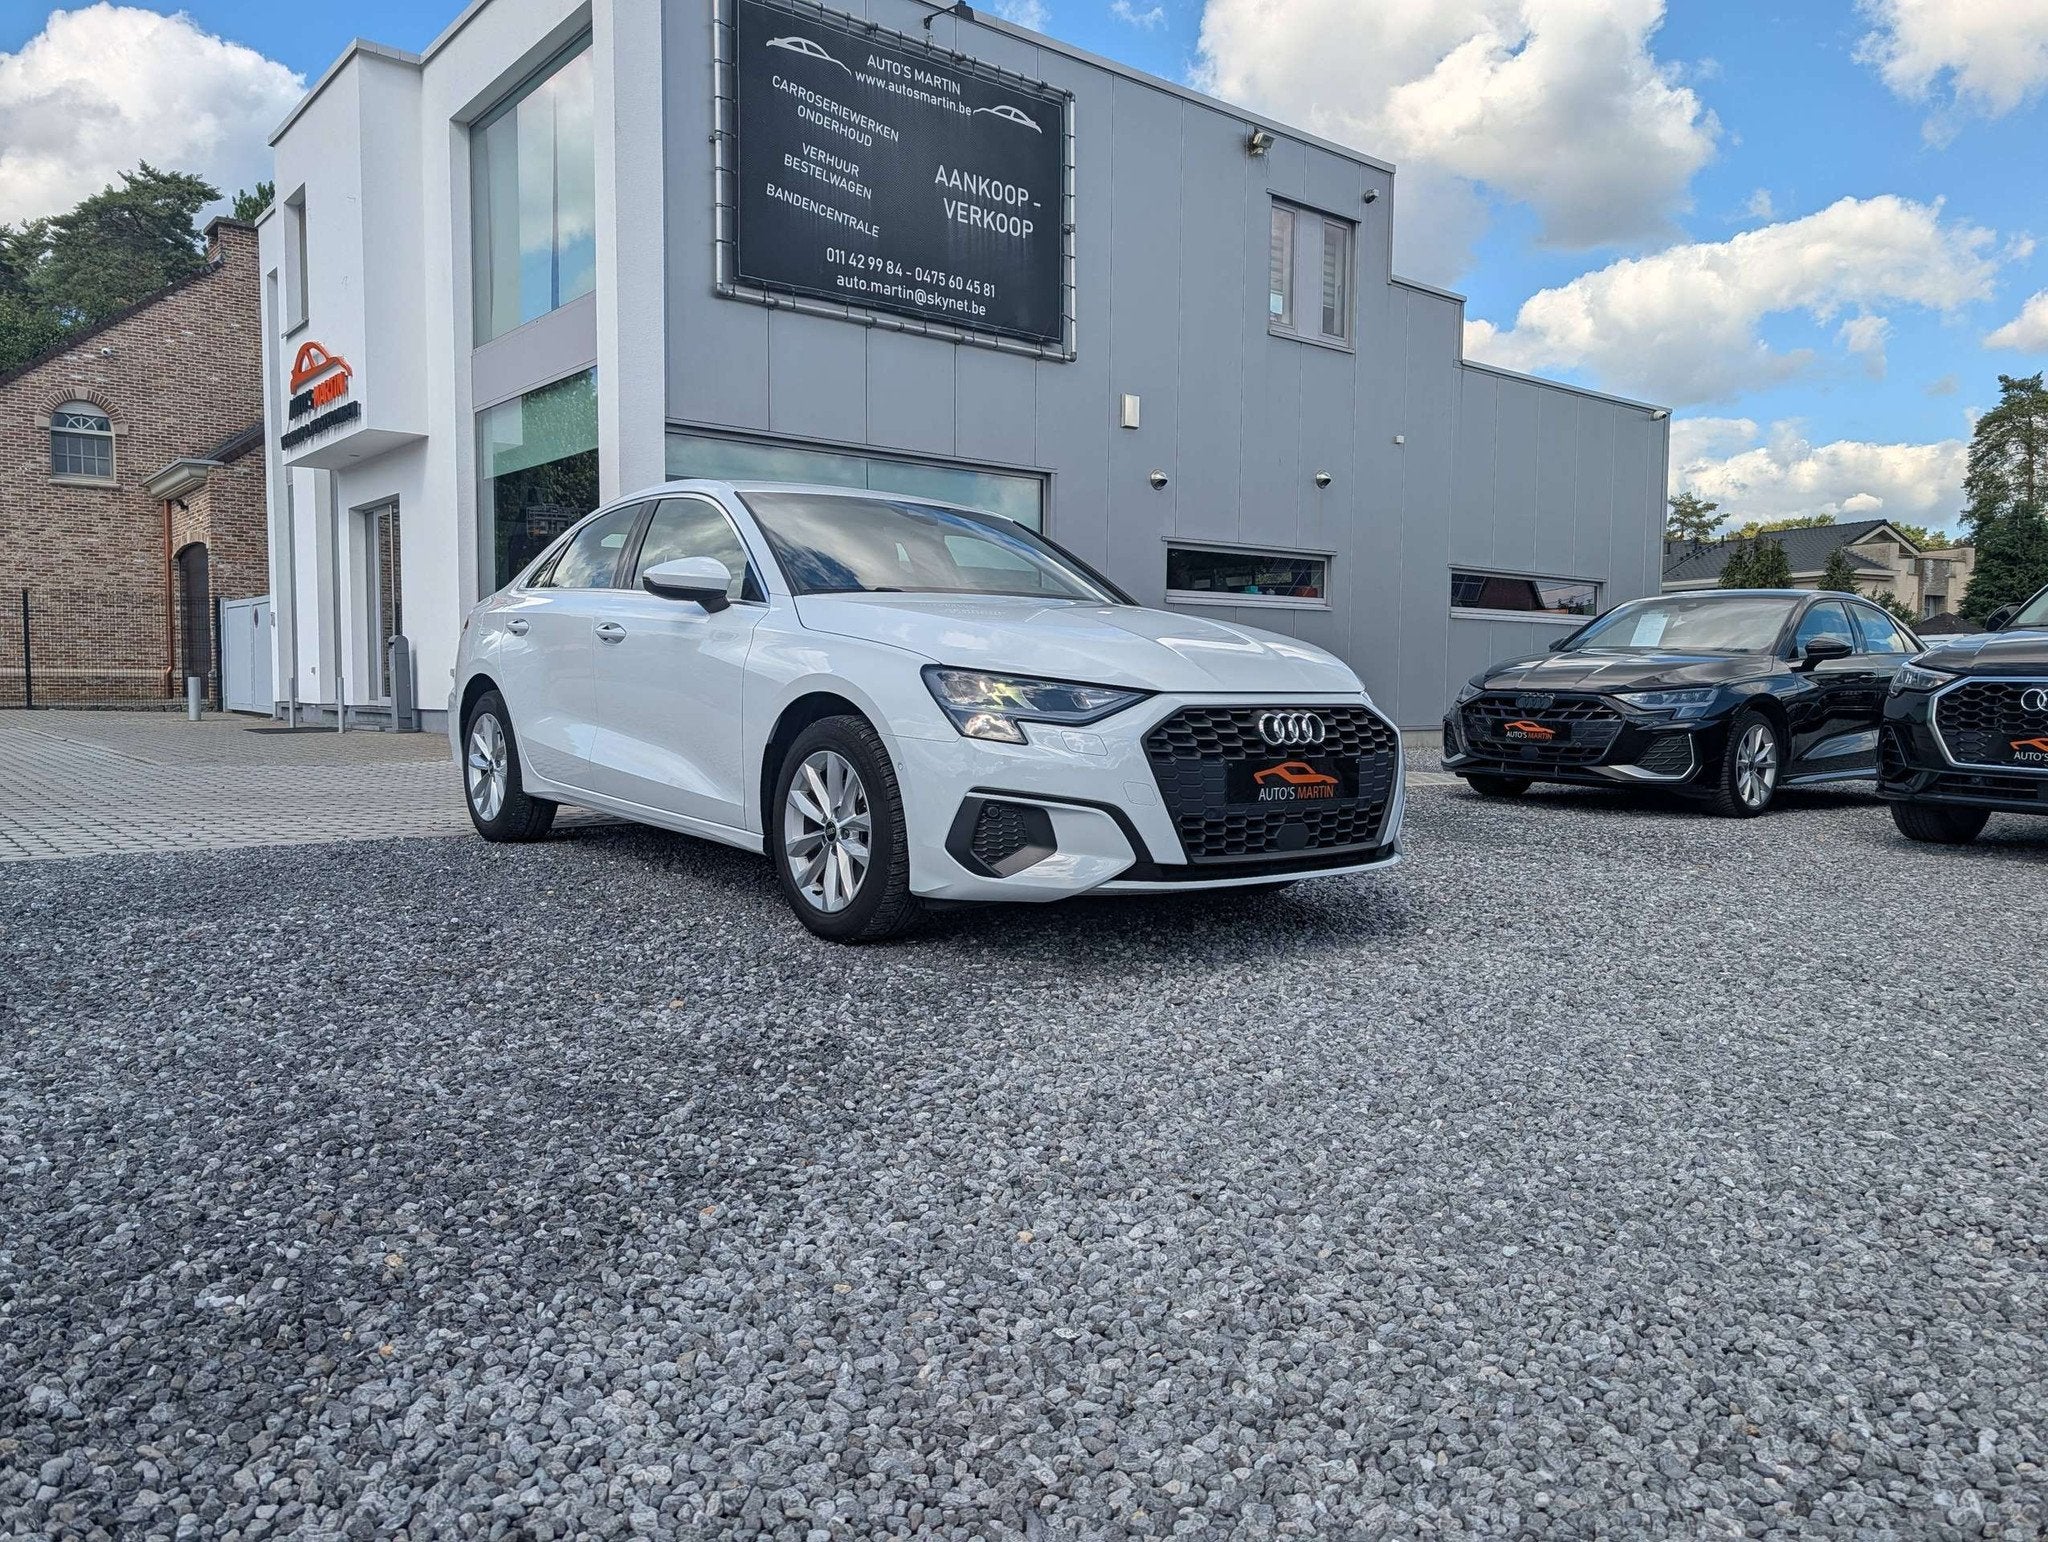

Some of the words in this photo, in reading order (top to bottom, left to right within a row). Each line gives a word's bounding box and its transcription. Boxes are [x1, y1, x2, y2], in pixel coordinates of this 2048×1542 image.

[855, 71, 972, 116] www.autosmartin.be
[867, 54, 912, 79] AUTO'S
[914, 68, 961, 95] MARTIN
[771, 75, 899, 142] CARROSERIEWERKEN
[797, 105, 872, 147] ONDERHOUD
[784, 153, 872, 200] BESTELWAGEN
[802, 142, 860, 178] VERHUUR
[934, 164, 1029, 207] AANKOOP
[766, 182, 880, 238] BANDENCENTRALE
[943, 197, 1034, 239] VERKOOP
[836, 274, 986, 316] auto.martin@skynet.be
[915, 266, 946, 286] 0475
[948, 274, 963, 290] 60
[966, 279, 981, 295] 45
[983, 283, 995, 298] 81
[1506, 731, 1528, 739] AUTO'S
[1528, 732, 1553, 740] MARTIN
[1258, 786, 1296, 801] AUTO'S
[1297, 784, 1334, 799] MARTIN
